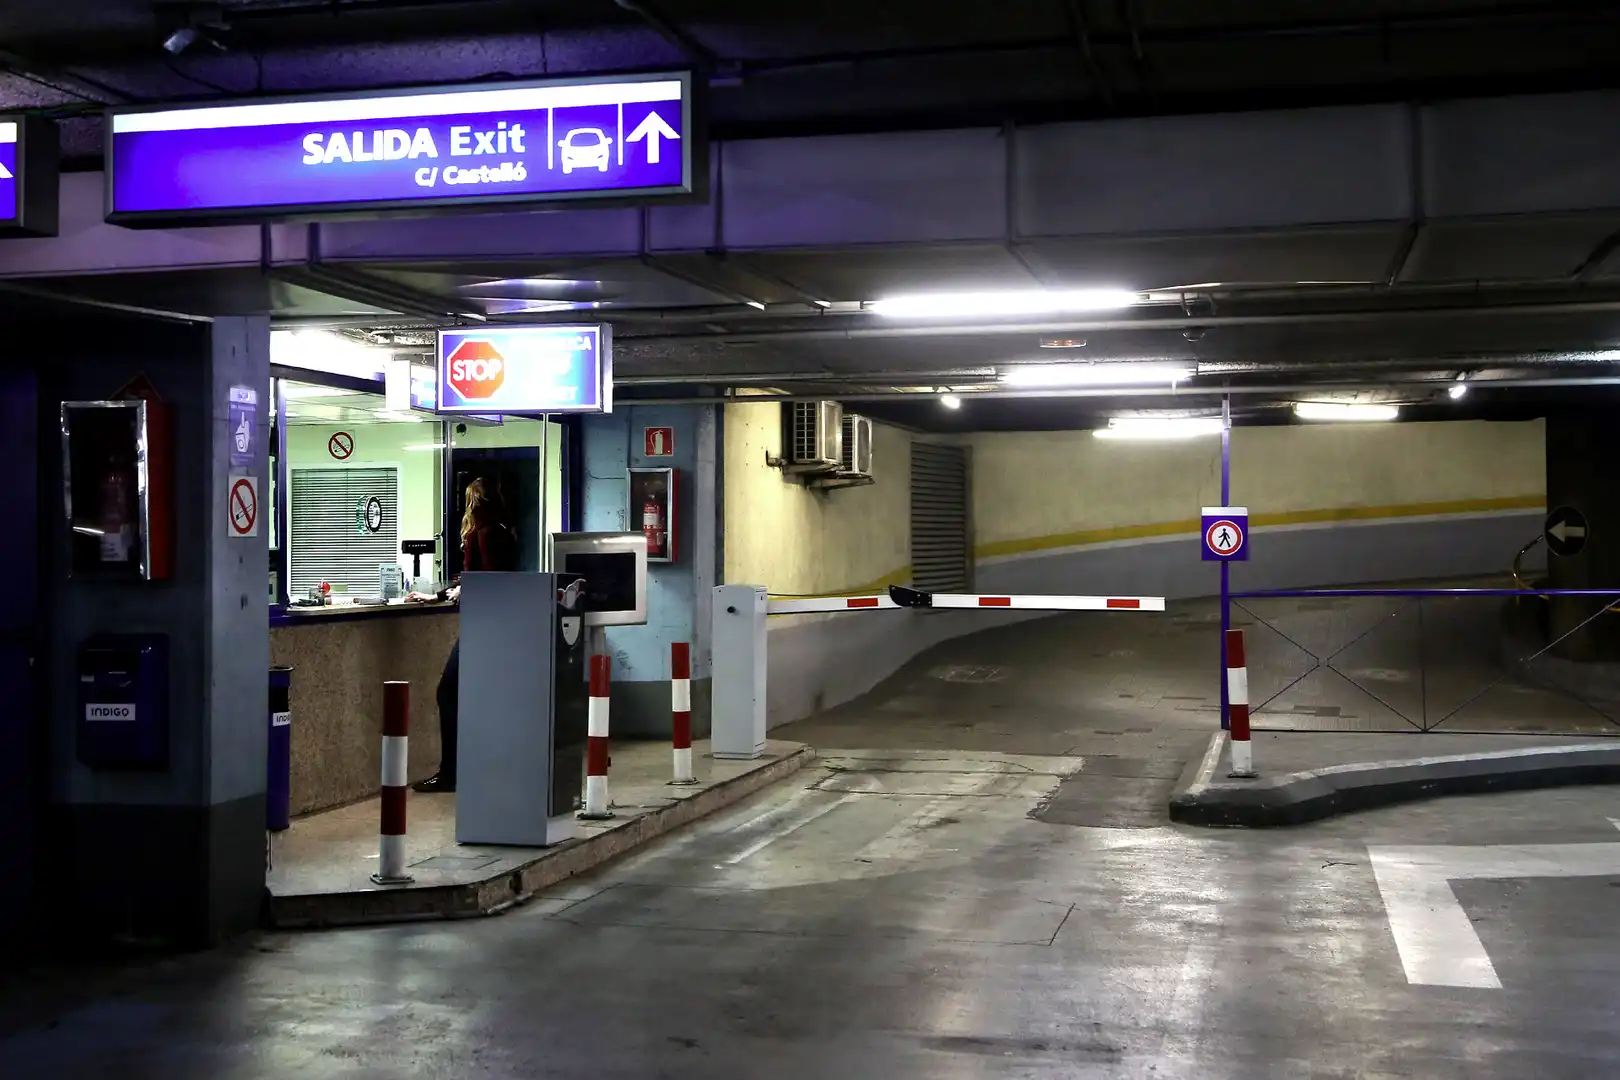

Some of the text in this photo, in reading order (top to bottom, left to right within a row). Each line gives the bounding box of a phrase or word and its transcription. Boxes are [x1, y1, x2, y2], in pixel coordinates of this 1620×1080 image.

[302, 121, 526, 165] SALIDA Exit
[414, 162, 528, 187] C/ Castelló
[452, 358, 503, 382] STOP
[90, 707, 130, 718] INDIGO
